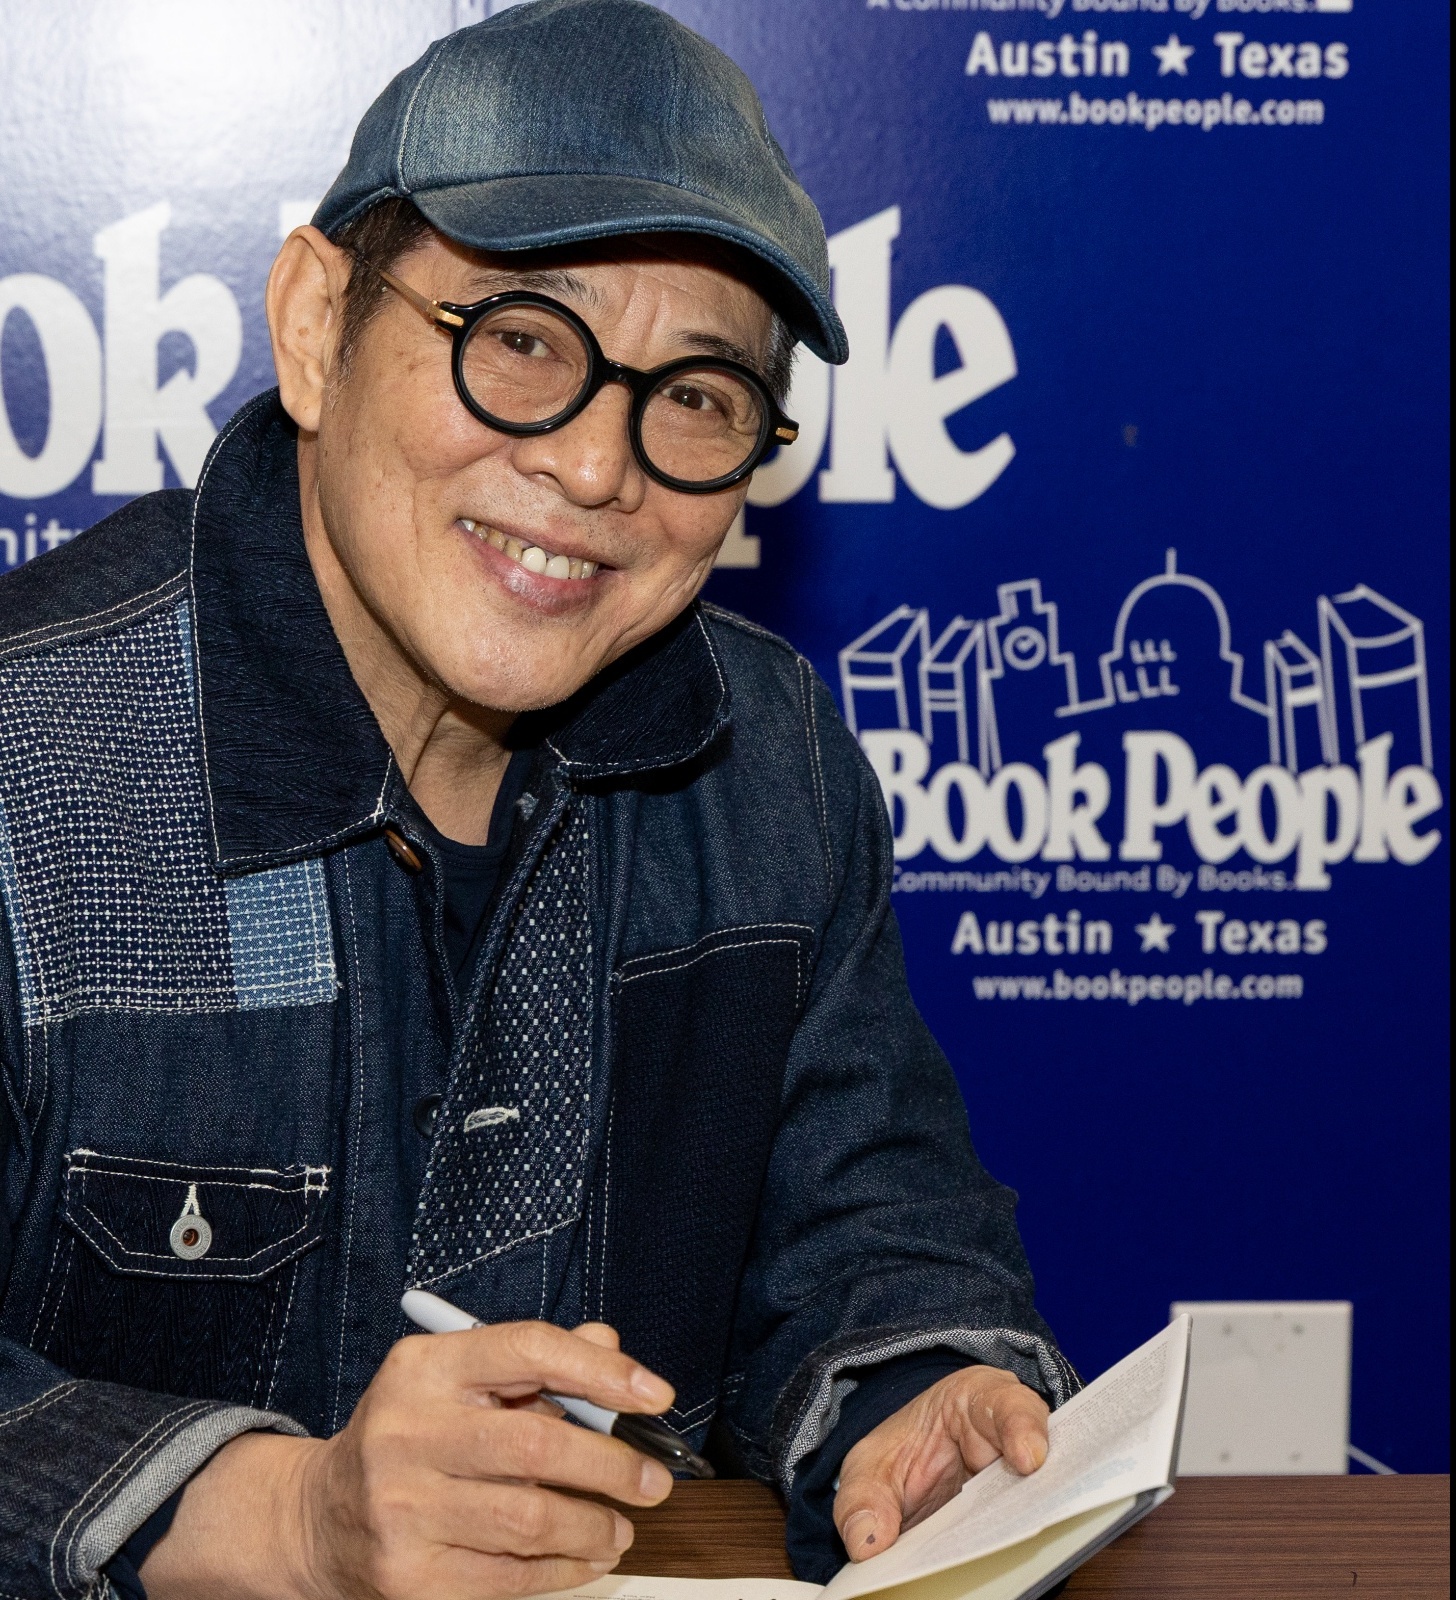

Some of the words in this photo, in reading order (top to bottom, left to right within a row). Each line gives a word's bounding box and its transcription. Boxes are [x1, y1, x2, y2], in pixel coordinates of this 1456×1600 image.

[964, 29, 1131, 77] Austin
[1213, 31, 1350, 78] Texas
[987, 91, 1325, 132] www.bookpeople.com
[859, 730, 1111, 862] Book
[1119, 730, 1443, 891] People
[1056, 864, 1150, 892] Bound
[1156, 864, 1194, 899] By
[950, 909, 1113, 955] Austin
[1195, 909, 1329, 956] Texas
[972, 967, 1305, 1005] www.bookpeople.com
